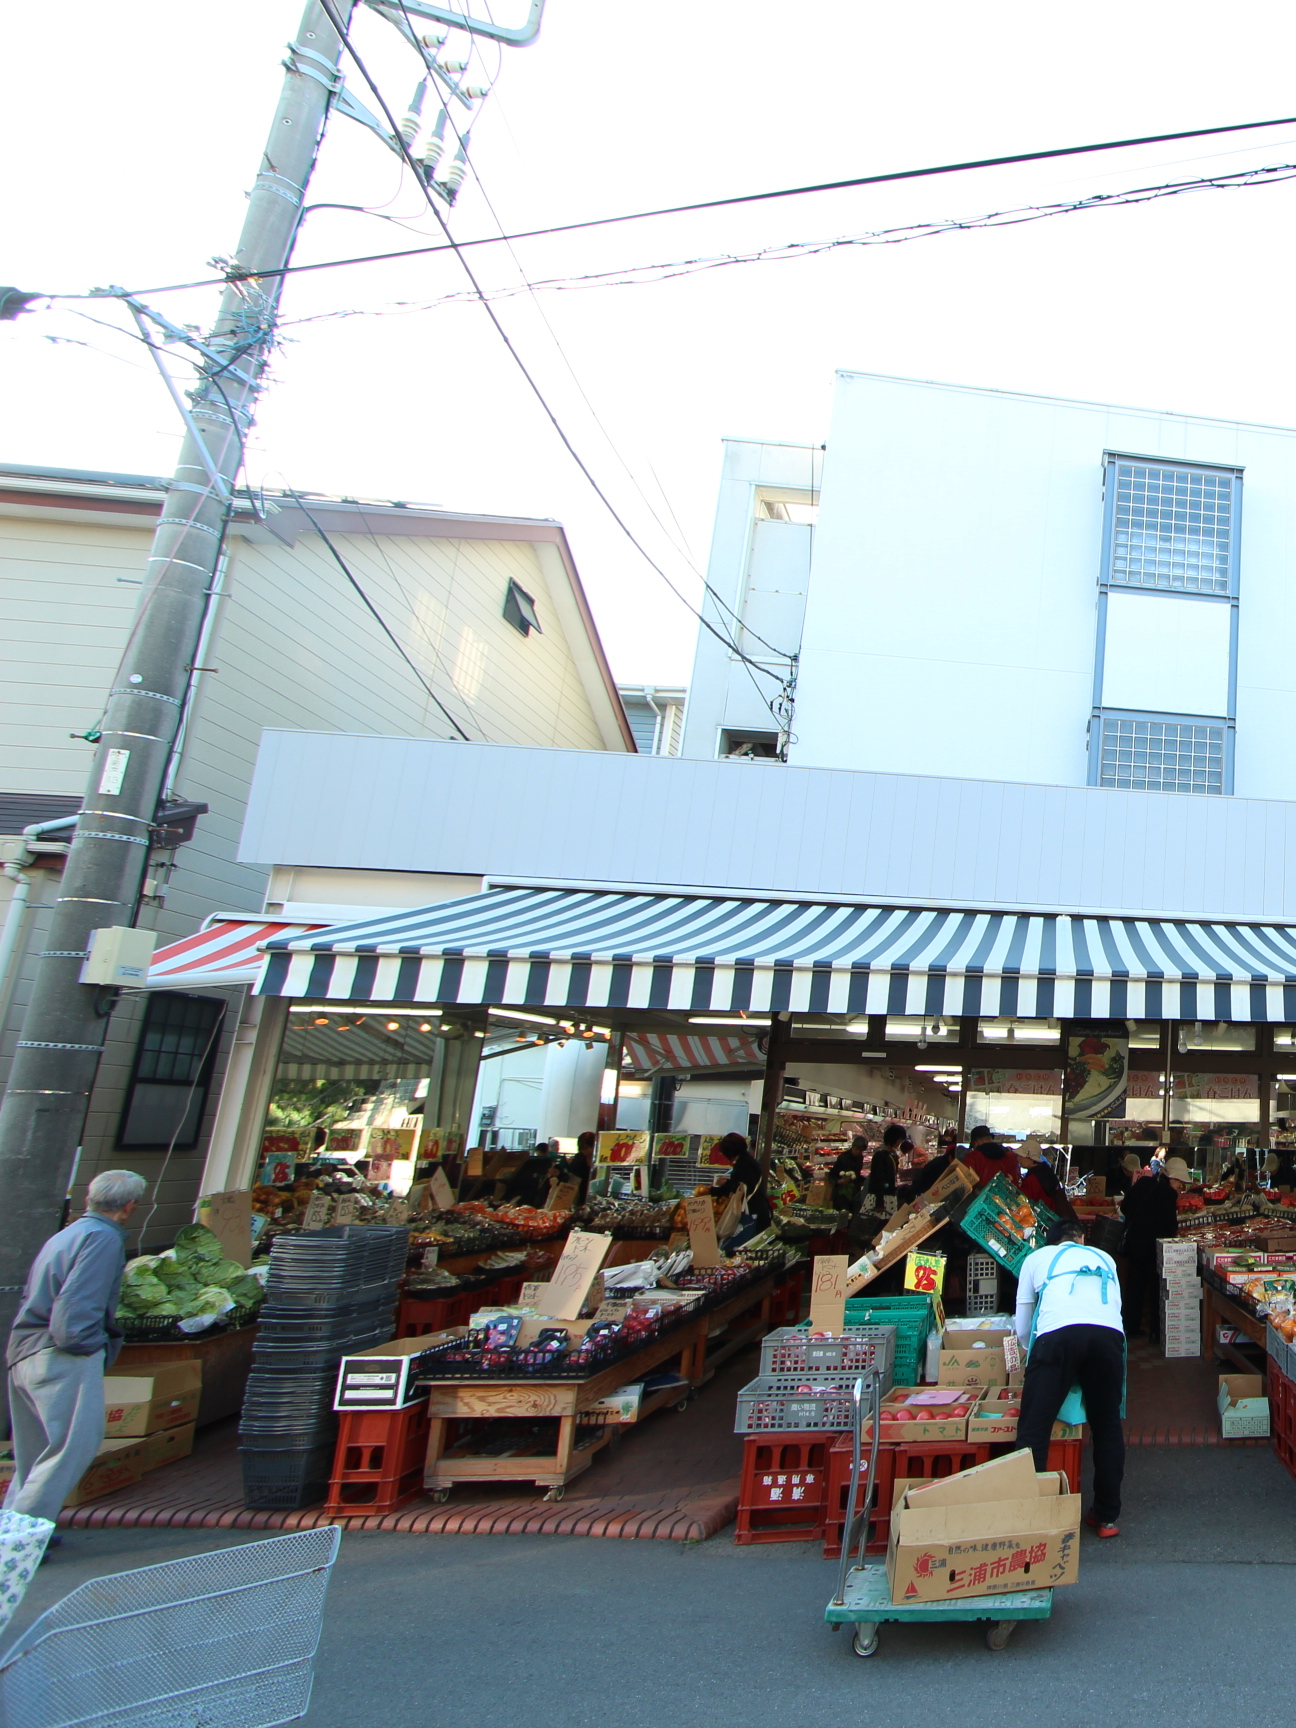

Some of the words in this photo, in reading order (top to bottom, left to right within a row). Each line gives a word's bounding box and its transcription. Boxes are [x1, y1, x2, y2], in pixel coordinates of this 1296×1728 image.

[1206, 1085, 1255, 1099] 春ごはん
[814, 1272, 840, 1294] 181
[913, 1265, 939, 1292] 95
[922, 1426, 963, 1436] トマト
[762, 1473, 815, 1486] 専用通箱
[769, 1486, 806, 1502] 清酒
[948, 1544, 981, 1556] 自然の味
[1049, 1531, 1076, 1584] 春キャベツ
[929, 1558, 947, 1570] 三浦
[946, 1542, 1048, 1594] 三浦市農協
